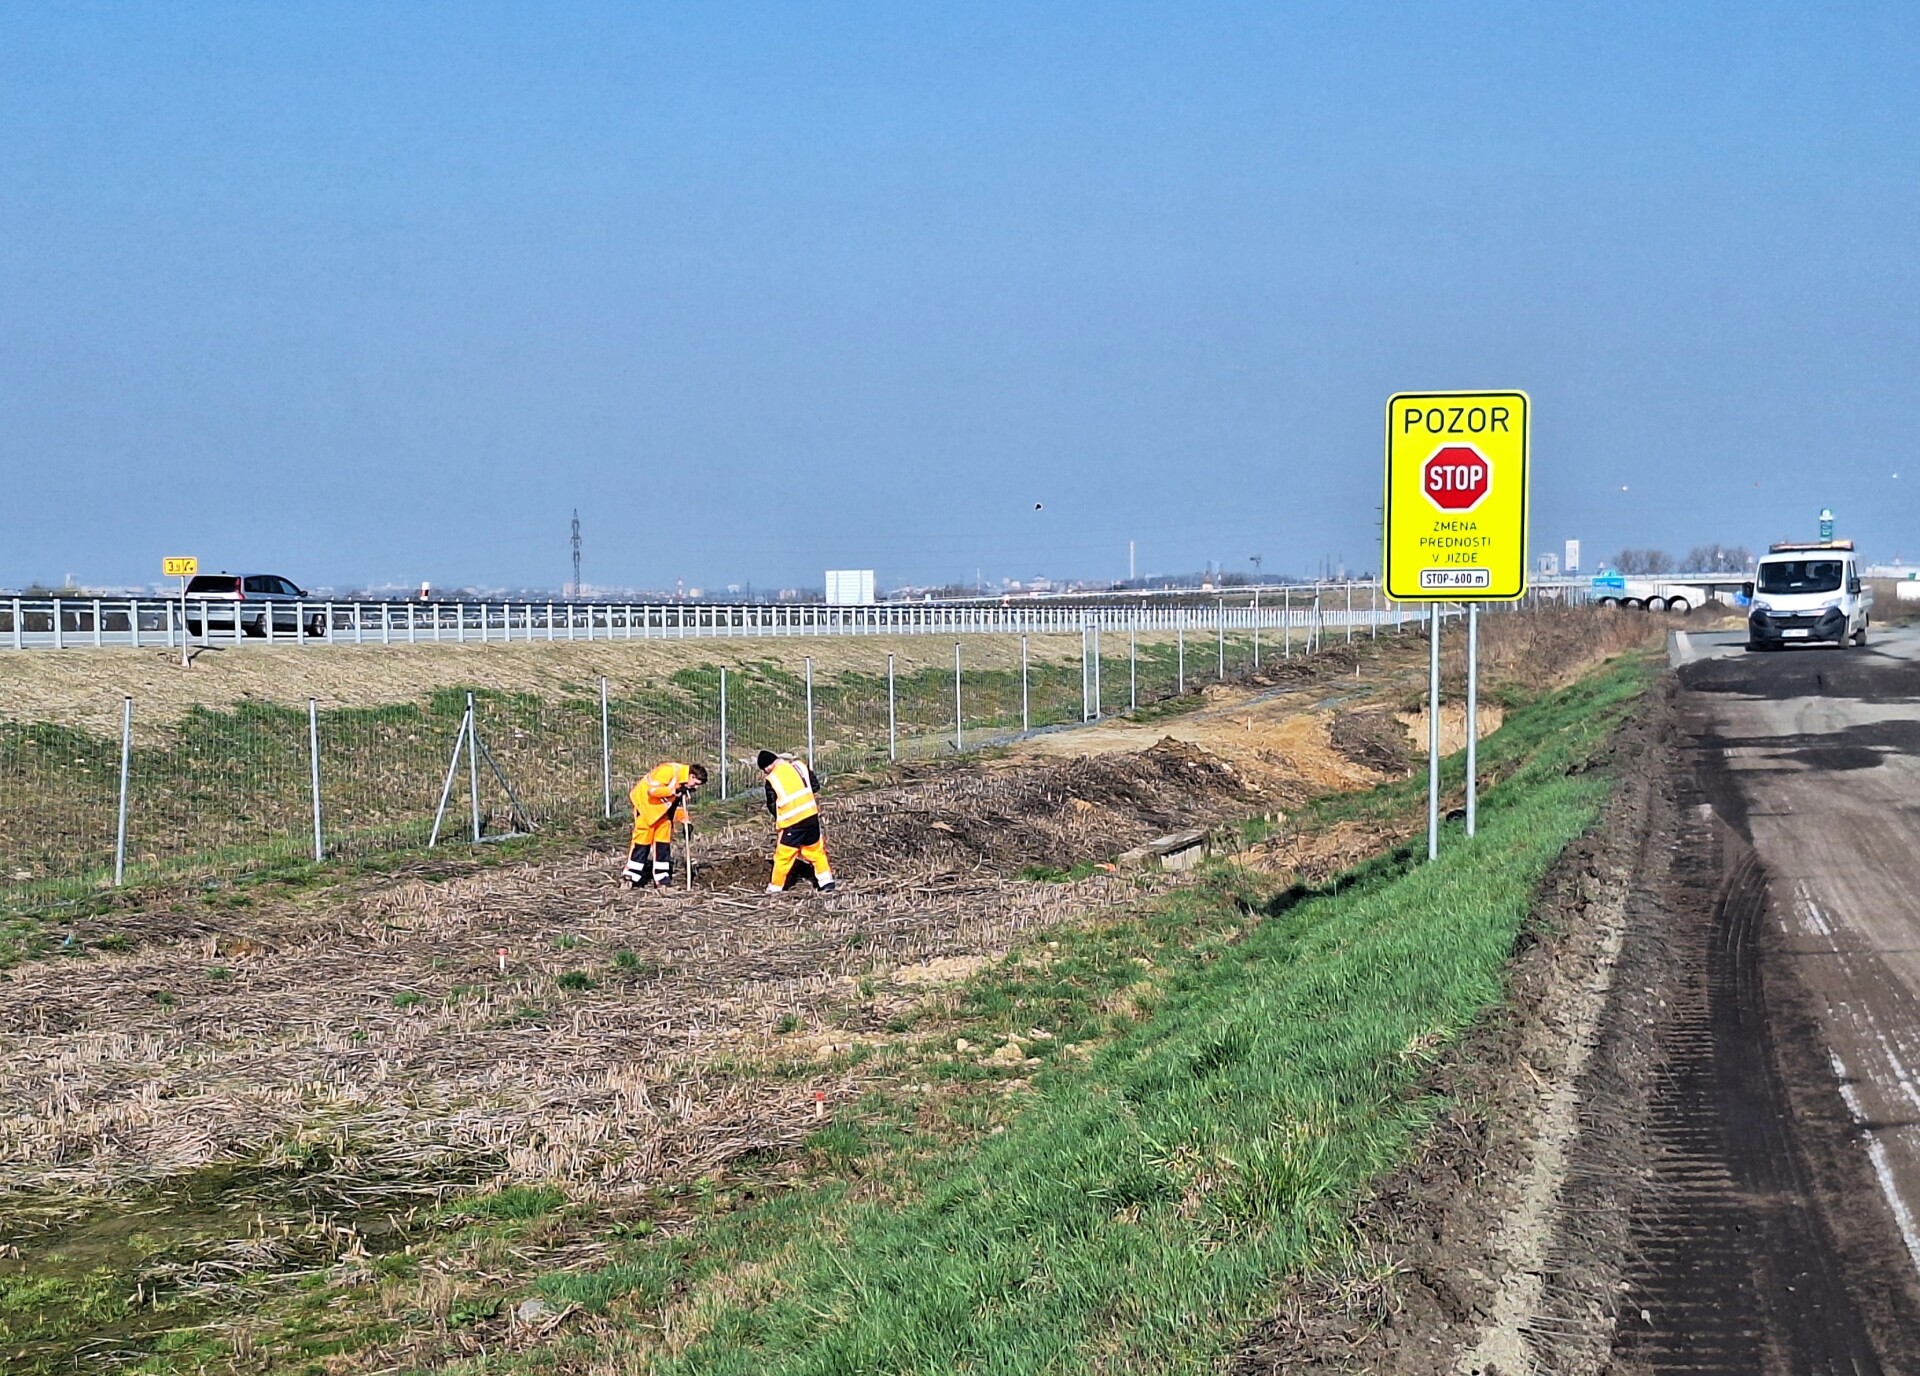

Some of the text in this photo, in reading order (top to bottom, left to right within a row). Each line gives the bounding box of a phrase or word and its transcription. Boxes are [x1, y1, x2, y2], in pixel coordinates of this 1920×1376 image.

[1404, 407, 1510, 434] POZOR
[1429, 465, 1483, 491] STOP
[1432, 553, 1439, 563] V
[1426, 572, 1484, 584] STOP-600 m
